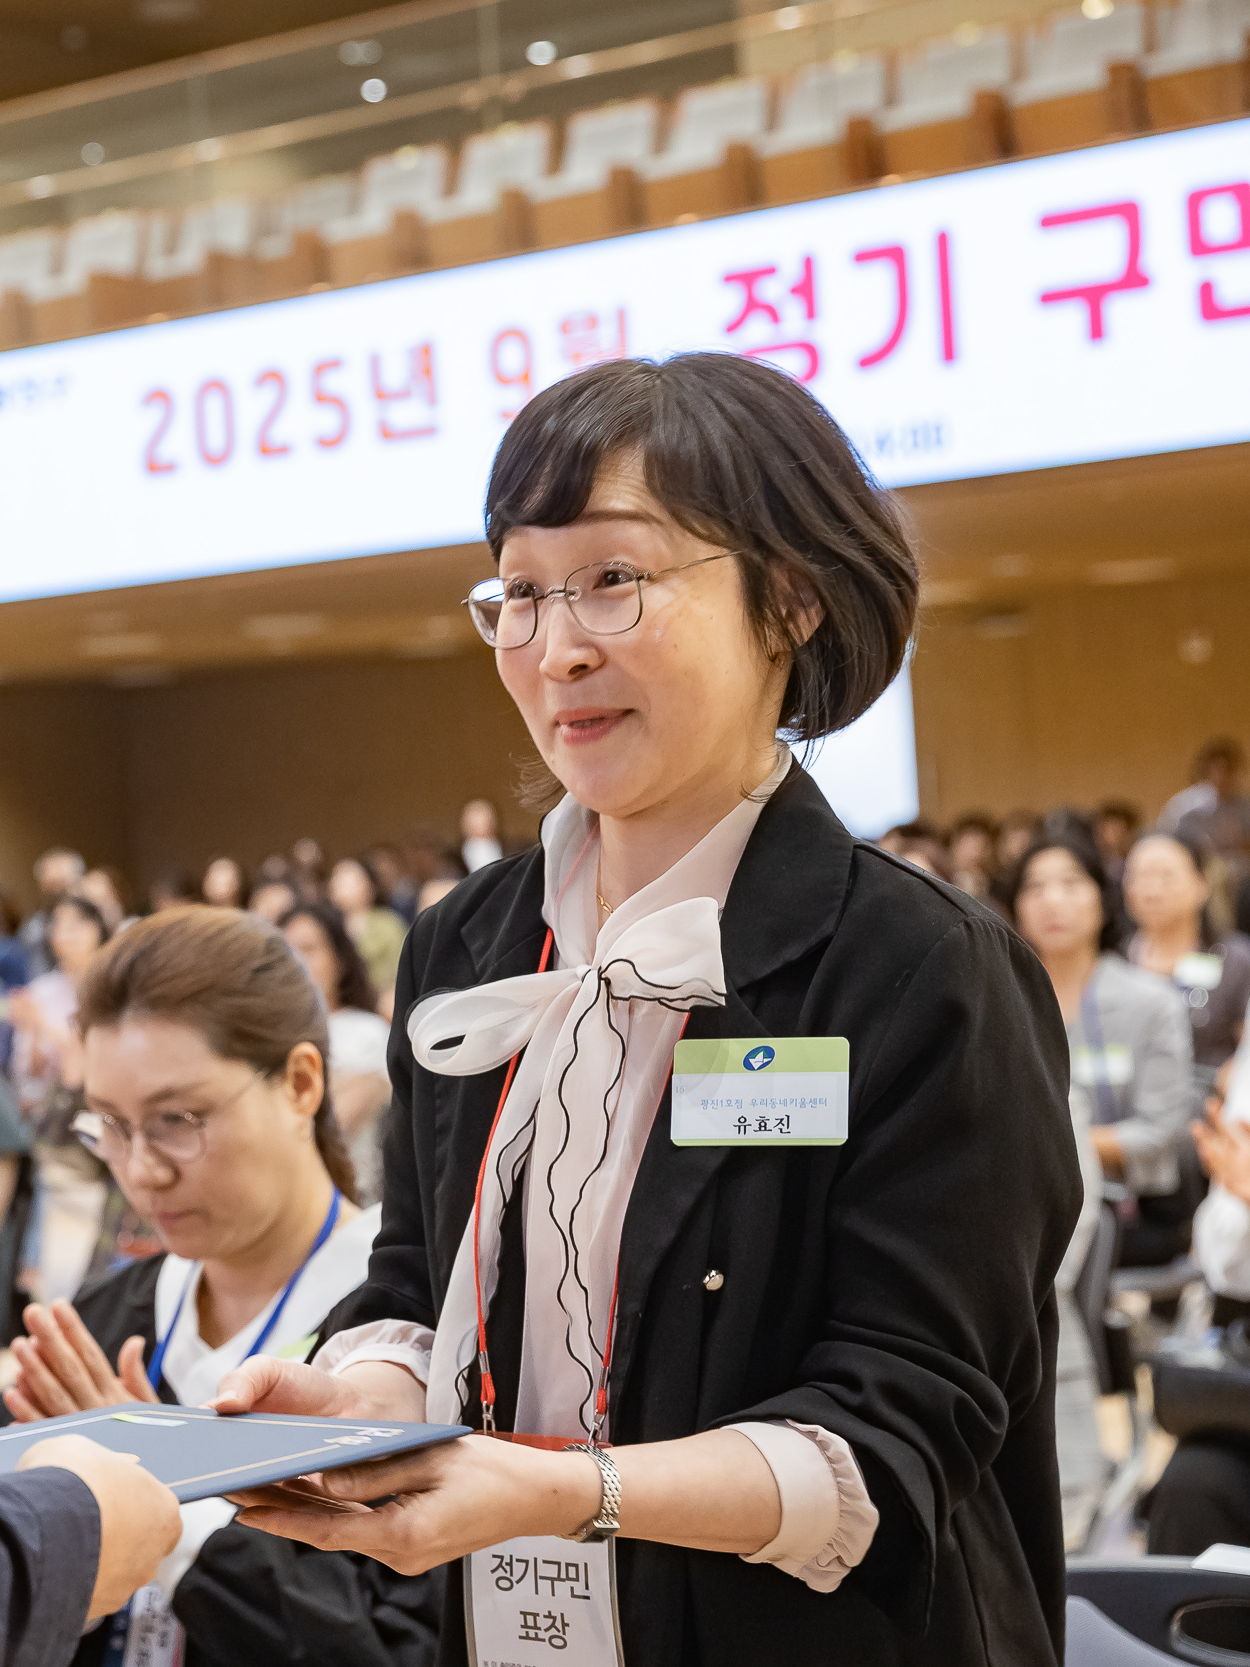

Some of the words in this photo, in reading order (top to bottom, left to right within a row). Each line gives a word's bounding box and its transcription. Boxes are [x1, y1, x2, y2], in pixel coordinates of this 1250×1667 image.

[141, 341, 440, 474] 2025년
[723, 231, 956, 384] 정기
[700, 1099, 743, 1110] 광진1호점
[749, 1097, 828, 1109] 우리동네키움센터
[733, 1114, 792, 1135] 유효진
[490, 1553, 591, 1600] 정기구민
[518, 1610, 570, 1650] 표창
